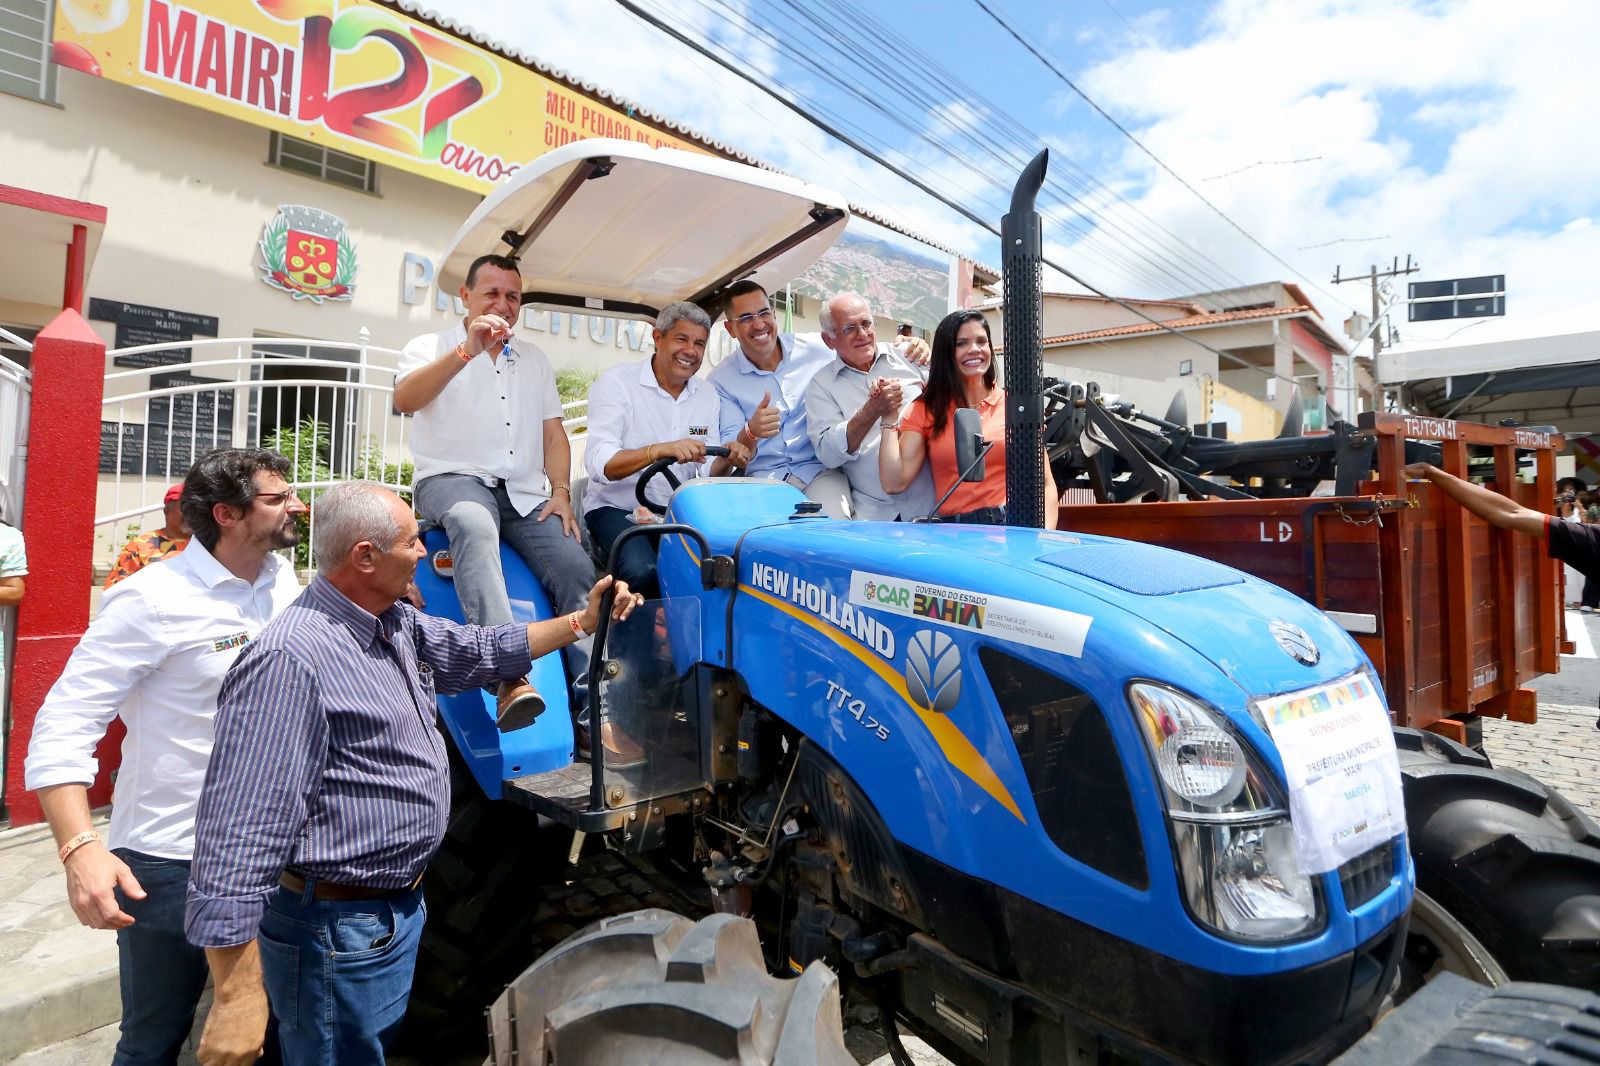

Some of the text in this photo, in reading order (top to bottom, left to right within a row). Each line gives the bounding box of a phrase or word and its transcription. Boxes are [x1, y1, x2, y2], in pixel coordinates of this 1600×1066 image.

[143, 3, 293, 117] MAIRI
[545, 91, 576, 124] MEU
[155, 320, 181, 331] MAIRI
[1404, 417, 1447, 438] TRITON
[876, 583, 910, 609] CAR
[915, 584, 988, 606] GOVERNO DO ESTADO
[752, 562, 896, 659] NEW HOLLAND
[913, 593, 986, 629] BAHIA
[826, 679, 890, 741] TT4.75
[1306, 751, 1347, 775] PREFEITURA
